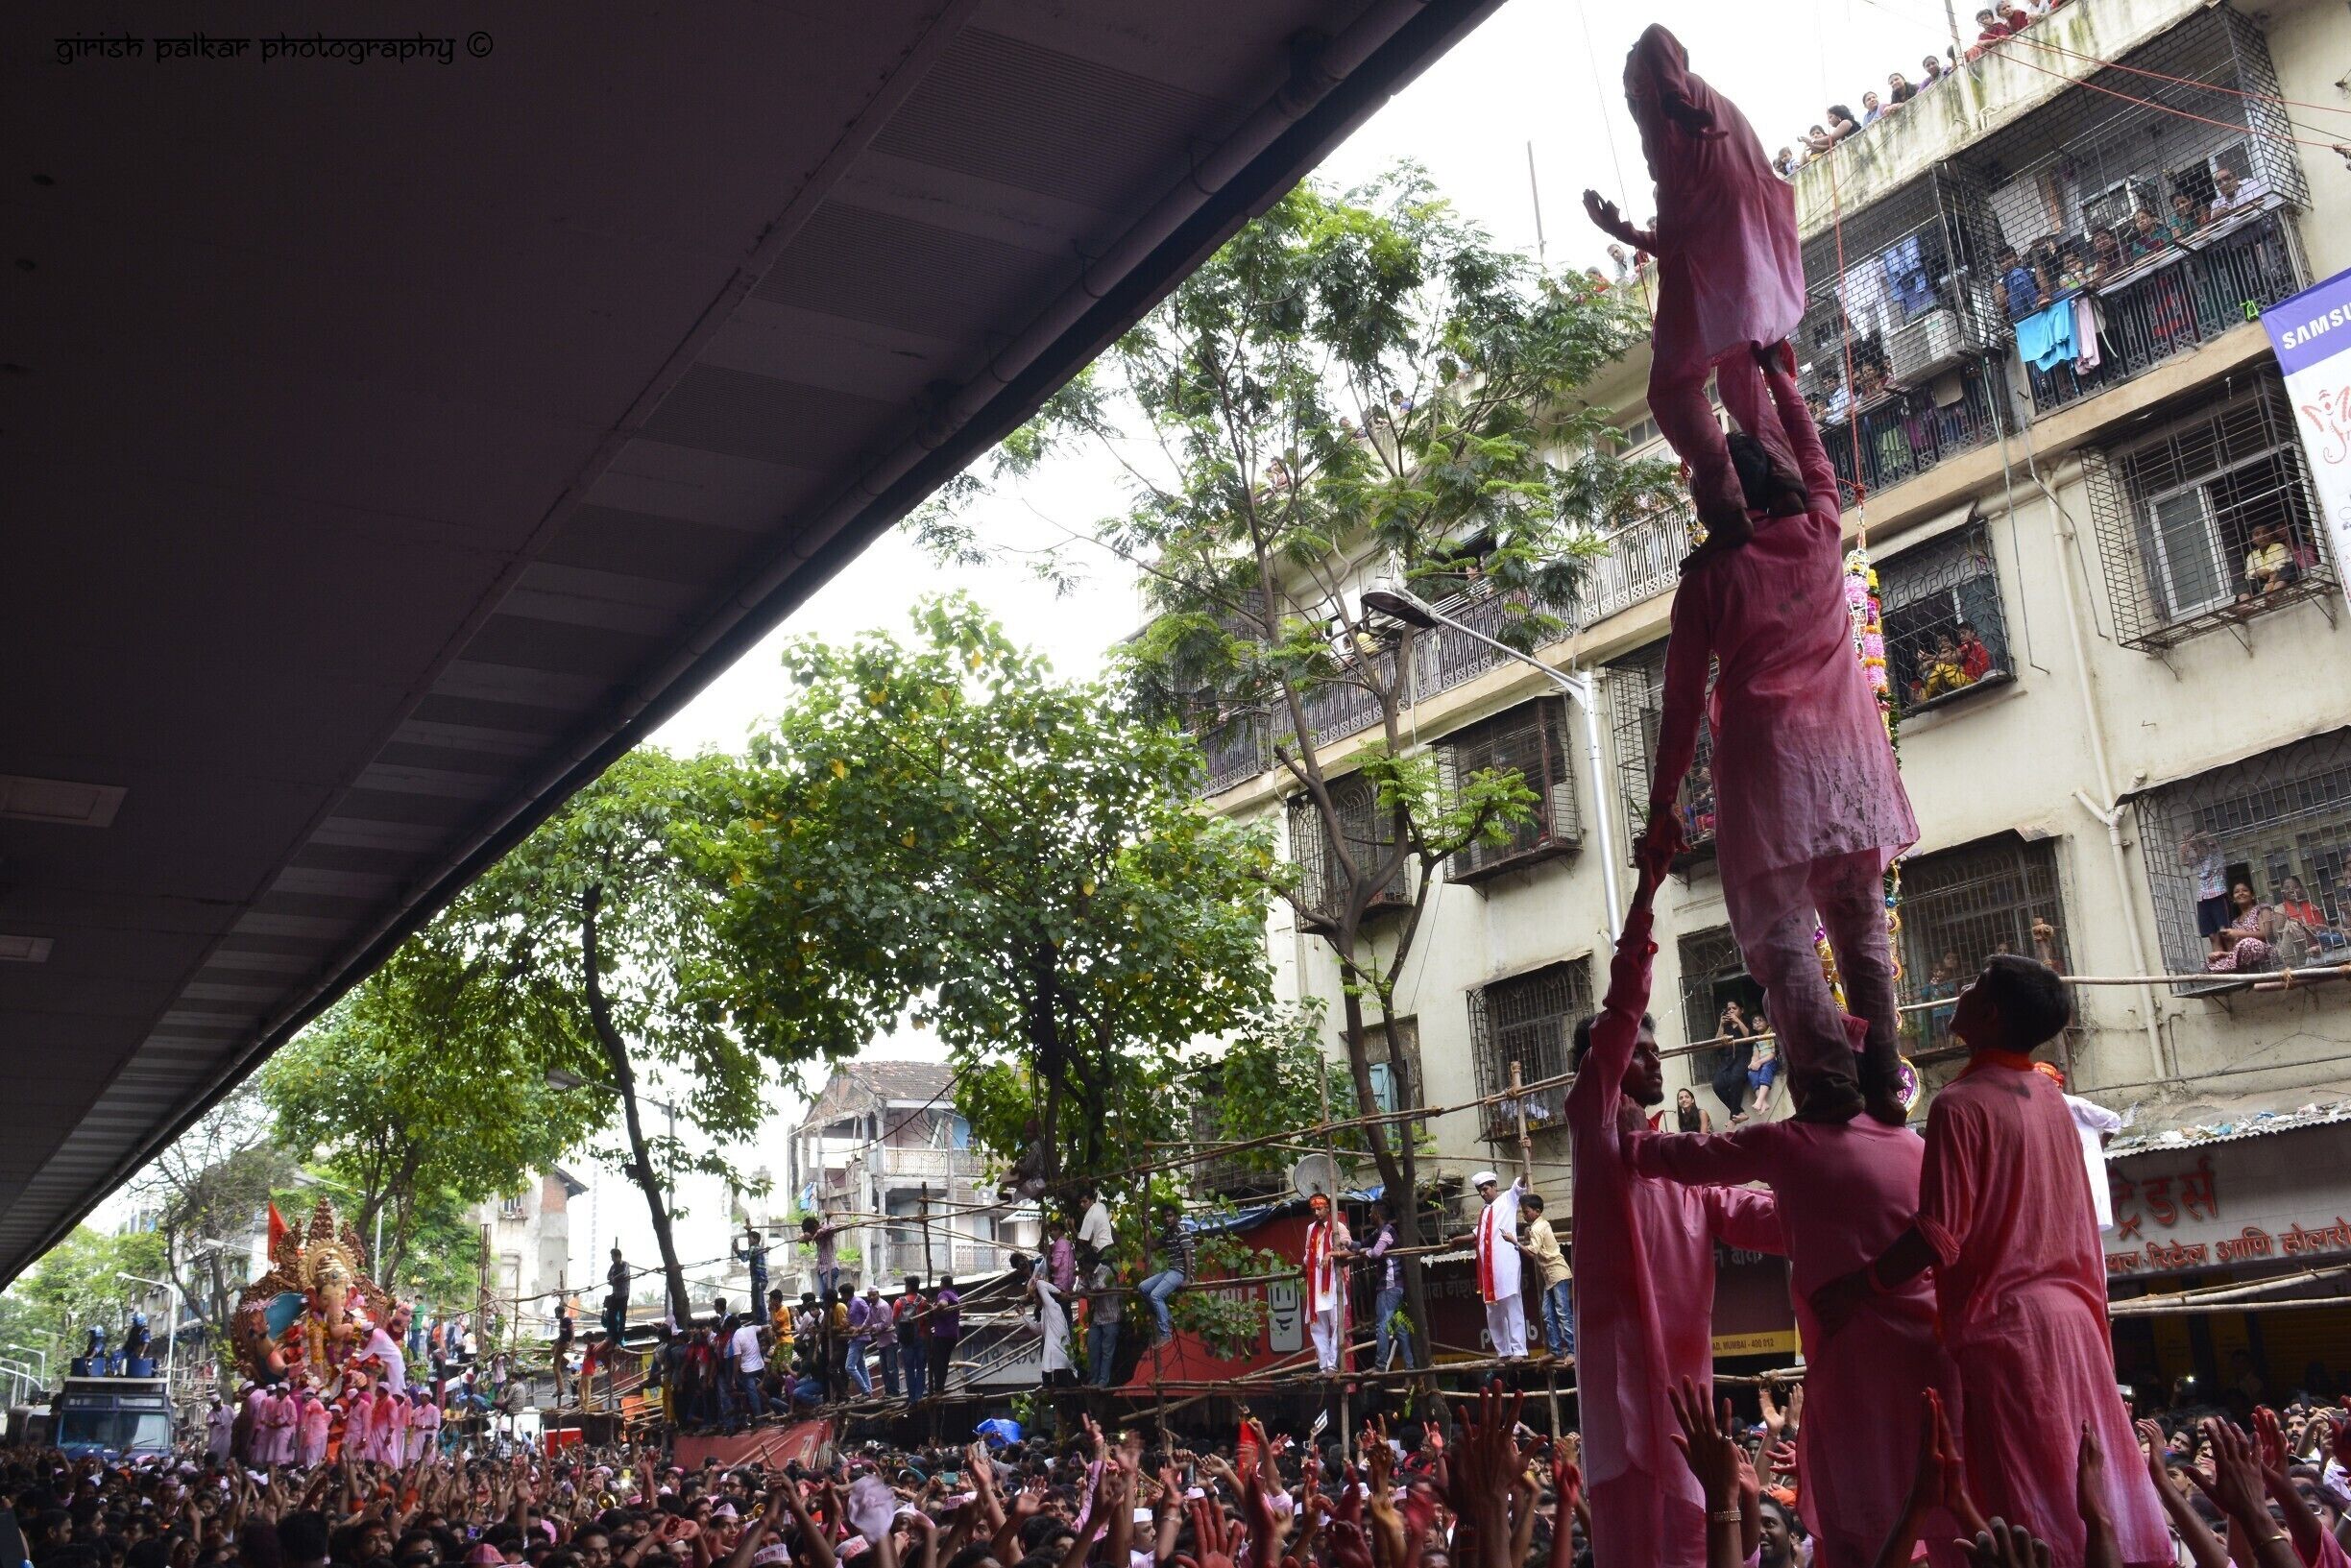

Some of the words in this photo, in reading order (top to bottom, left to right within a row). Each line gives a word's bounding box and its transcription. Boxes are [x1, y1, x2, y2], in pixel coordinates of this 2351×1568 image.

[2145, 1239, 2208, 1268] रिटेल
[2215, 1226, 2273, 1261] आणि
[1723, 1339, 1747, 1350] MUMBAI
